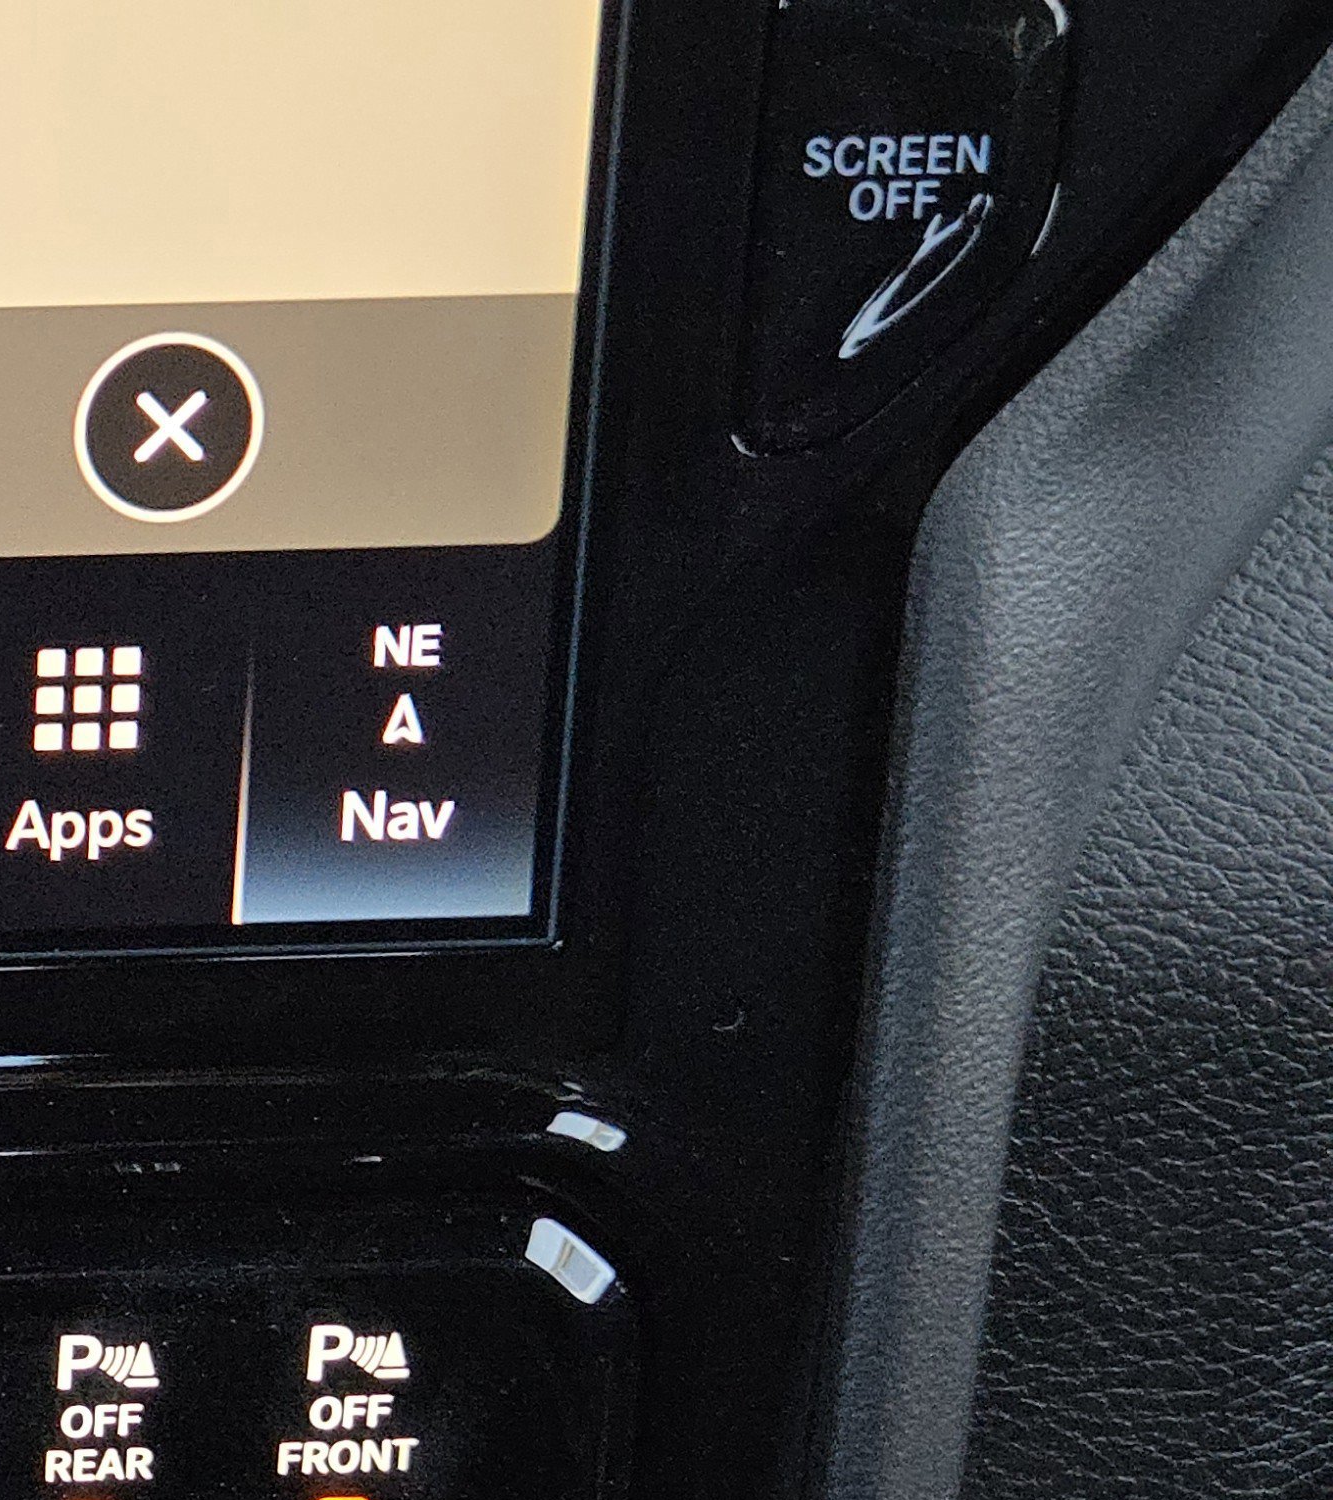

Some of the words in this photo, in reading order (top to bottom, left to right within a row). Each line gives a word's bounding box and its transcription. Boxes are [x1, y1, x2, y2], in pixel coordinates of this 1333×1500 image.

[803, 135, 990, 177] SCREEN
[849, 180, 941, 220] OFF
[374, 624, 442, 667] NE
[5, 800, 153, 861] Apps
[341, 790, 454, 841] Nav
[60, 1403, 144, 1439] OFF
[309, 1394, 394, 1431] OFF
[45, 1447, 153, 1483] REAR
[277, 1438, 419, 1475] FRONT
